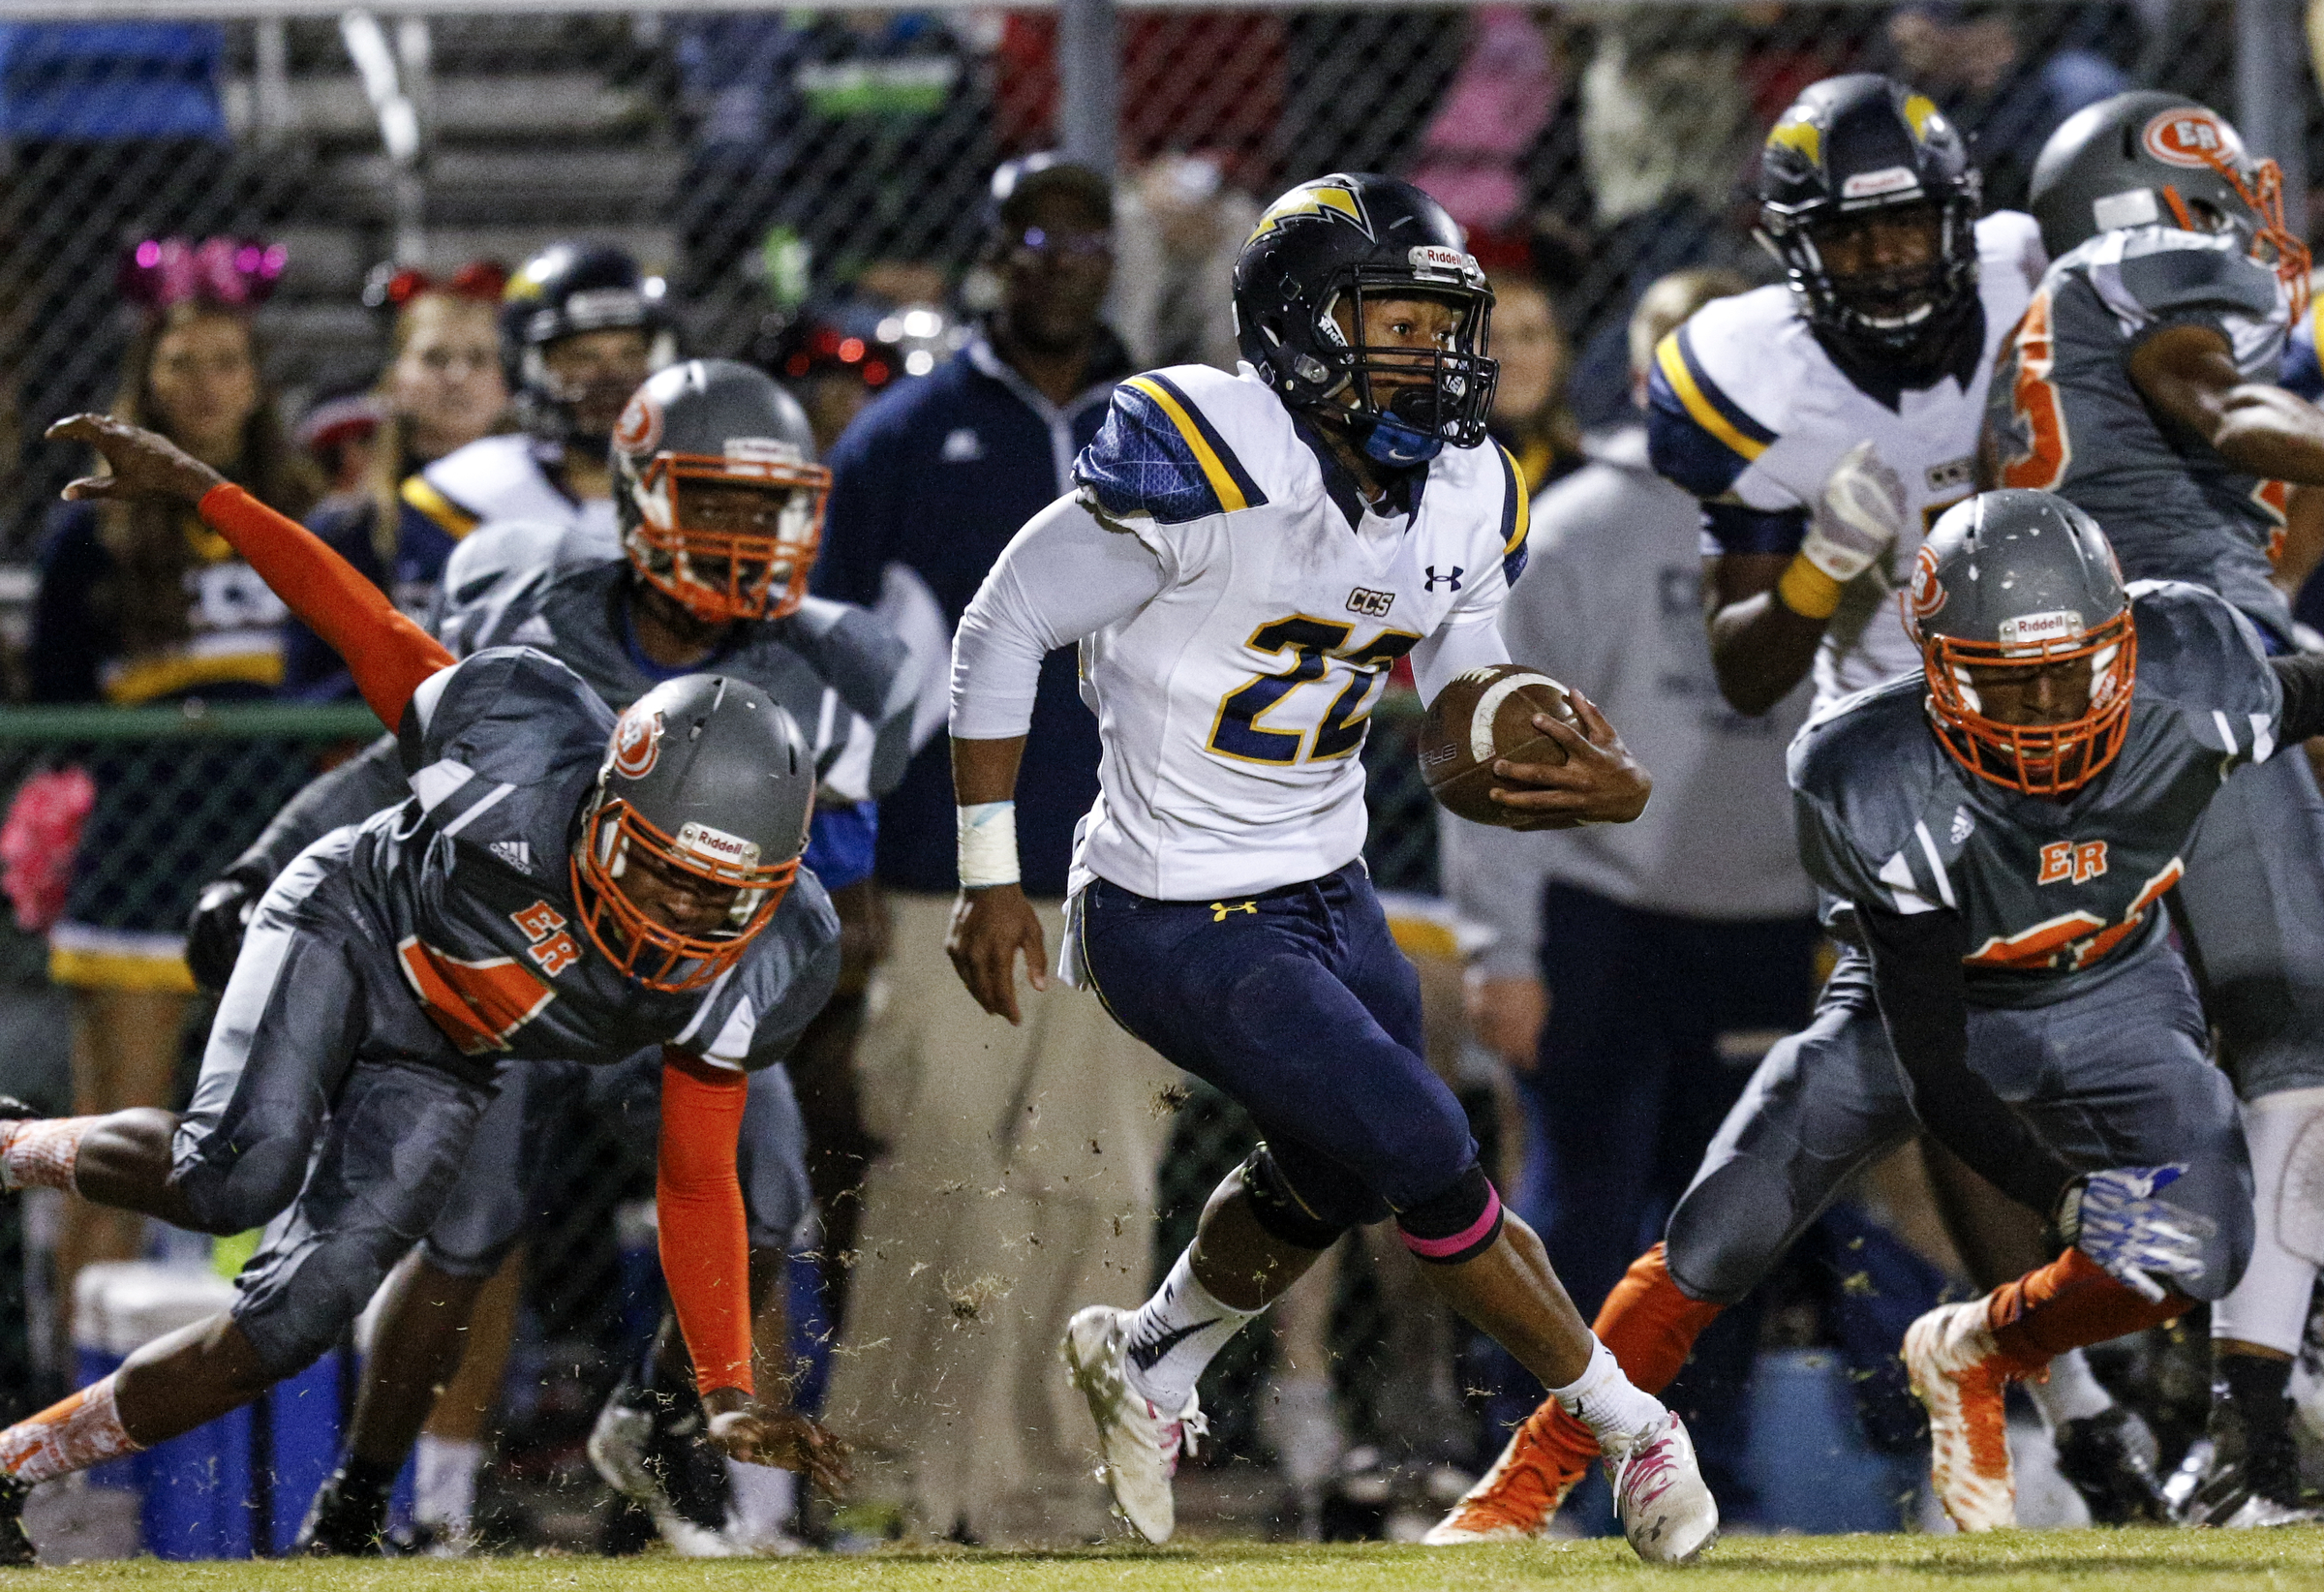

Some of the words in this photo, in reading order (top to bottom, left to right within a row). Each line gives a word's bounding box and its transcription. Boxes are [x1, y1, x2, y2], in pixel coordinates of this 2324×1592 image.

[2173, 121, 2219, 150] ER
[1426, 249, 1462, 266] Riddell
[1345, 587, 1395, 617] CCS
[2018, 615, 2064, 632] Riddell
[1205, 613, 1423, 766] 22
[698, 831, 743, 855] Riddell
[2037, 839, 2108, 886] ER
[509, 900, 583, 978] ER
